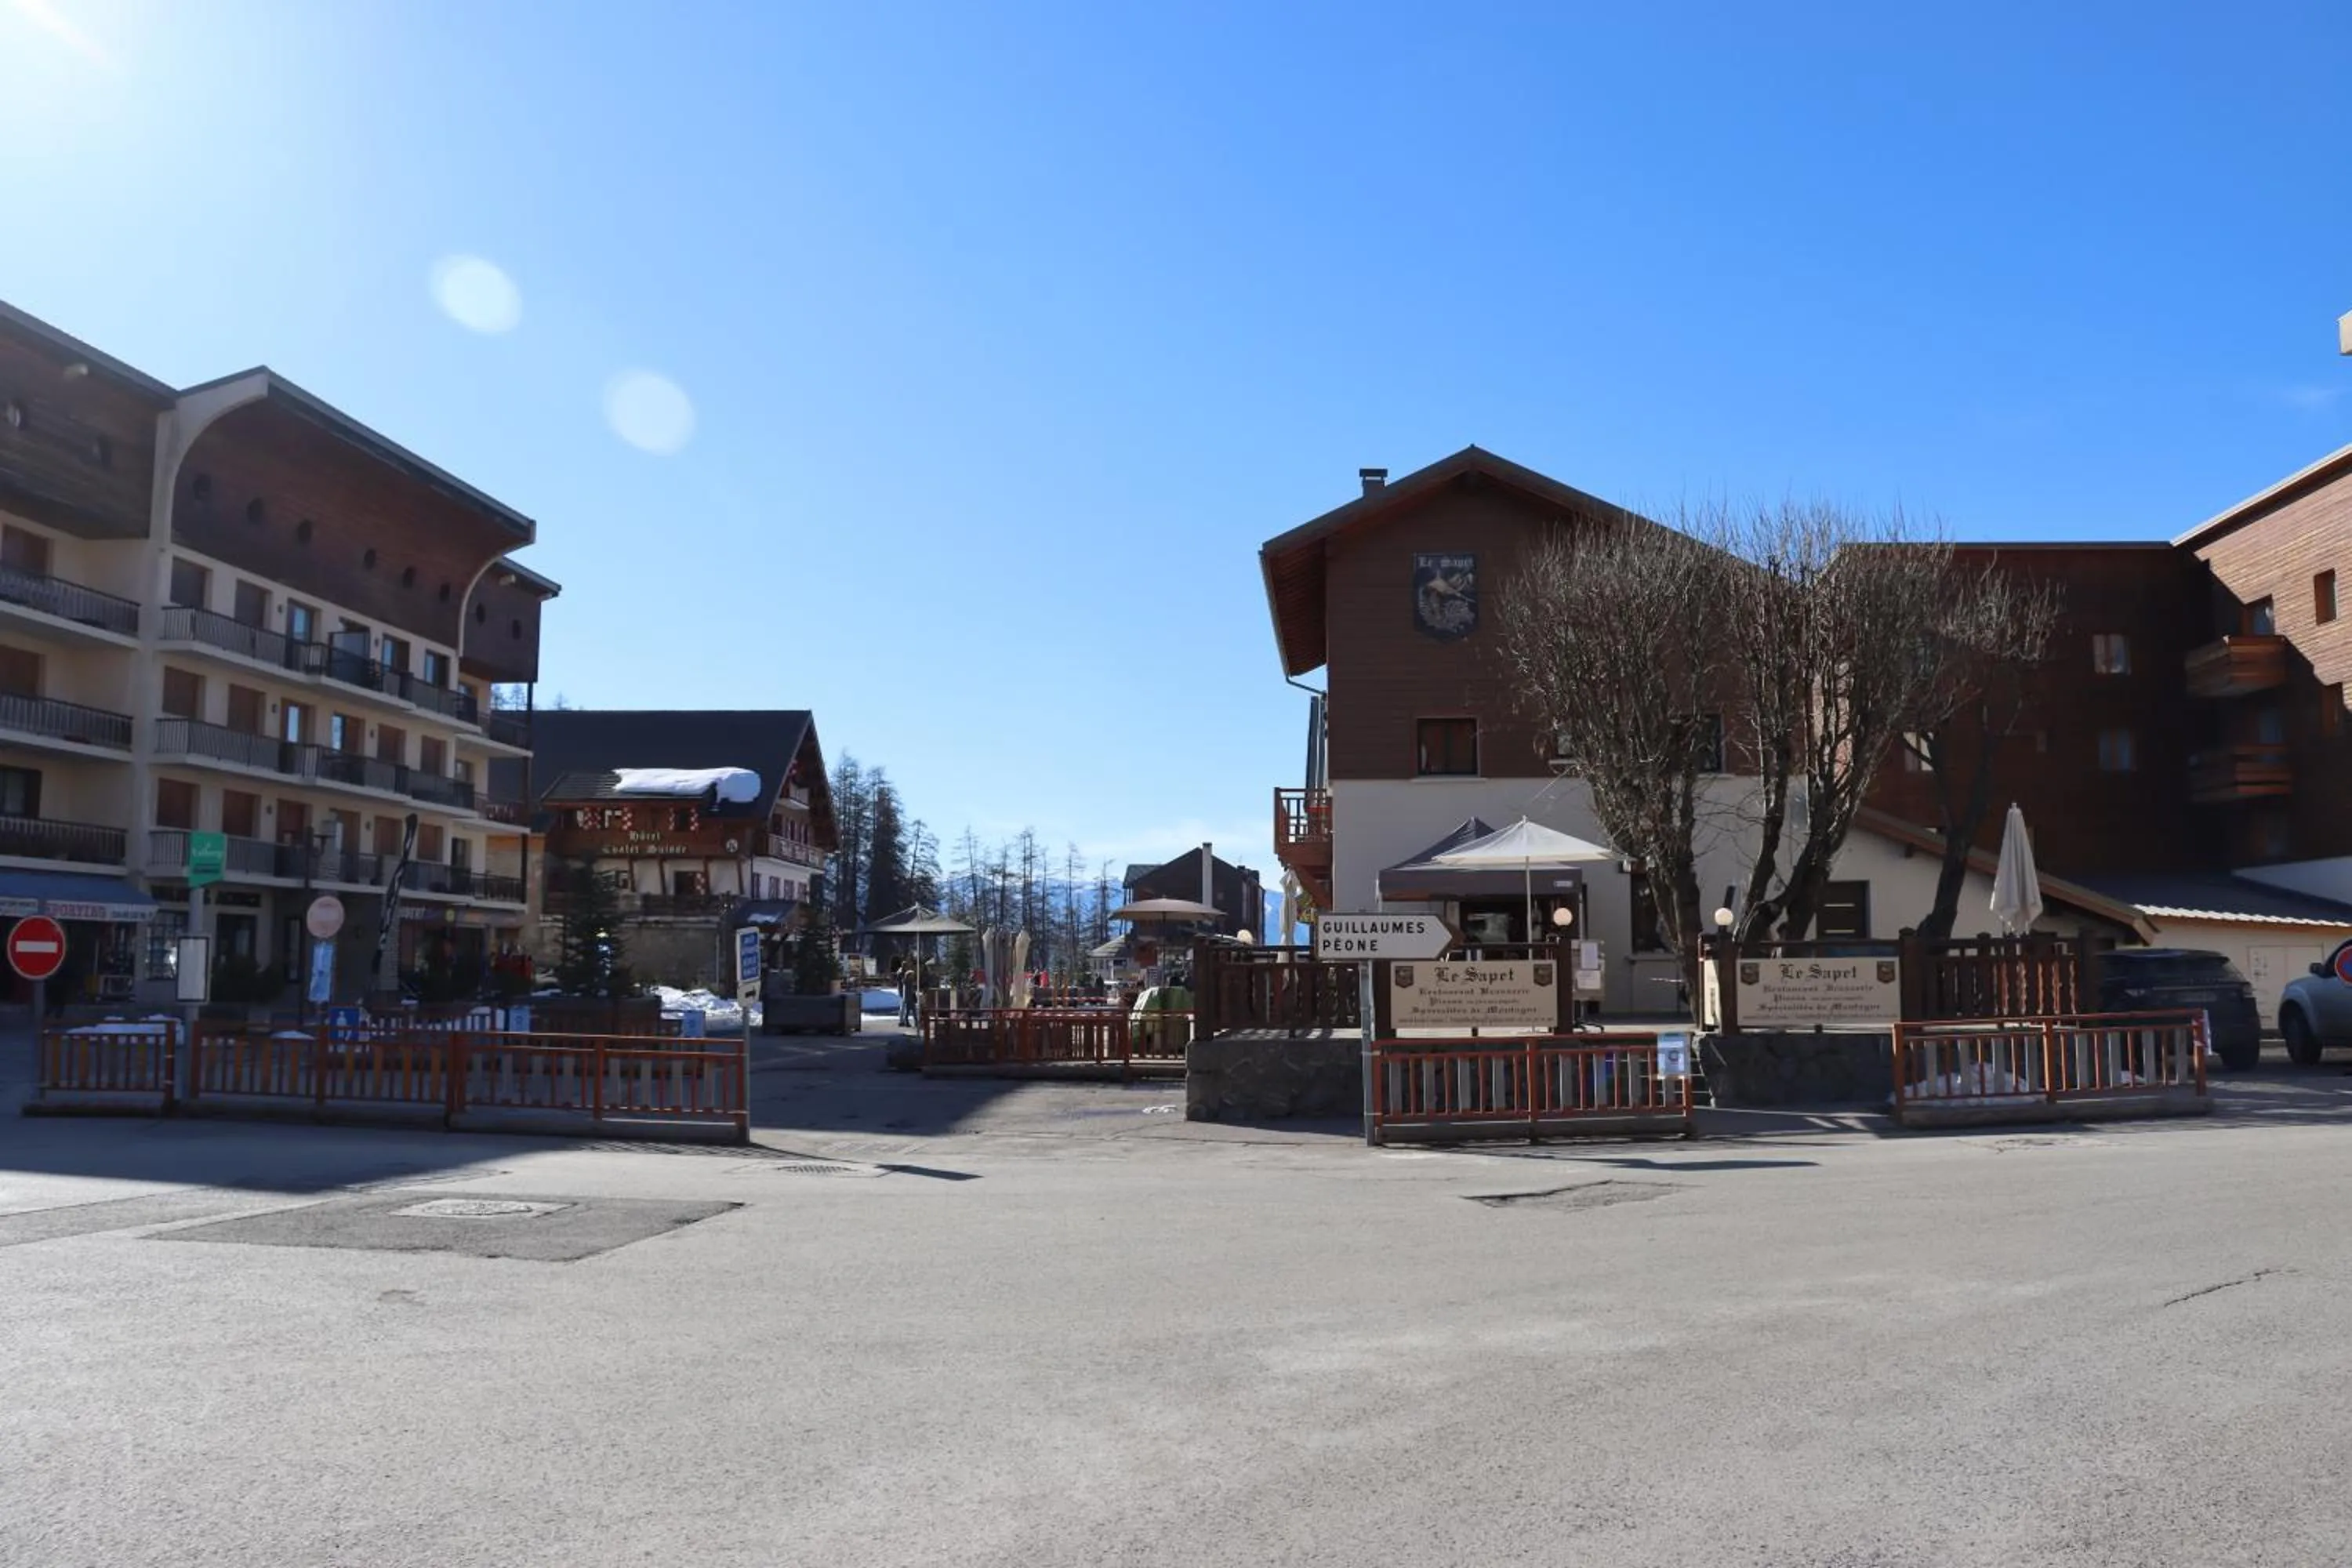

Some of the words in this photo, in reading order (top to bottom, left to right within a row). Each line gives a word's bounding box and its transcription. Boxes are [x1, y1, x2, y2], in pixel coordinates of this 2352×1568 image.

[1417, 556, 1433, 568] Le
[1322, 921, 1425, 934] GUILLAUMES
[1434, 966, 1459, 982] Le
[1464, 966, 1515, 985] Sapet
[1778, 963, 1803, 980] Le
[1806, 963, 1857, 982] Sapet
